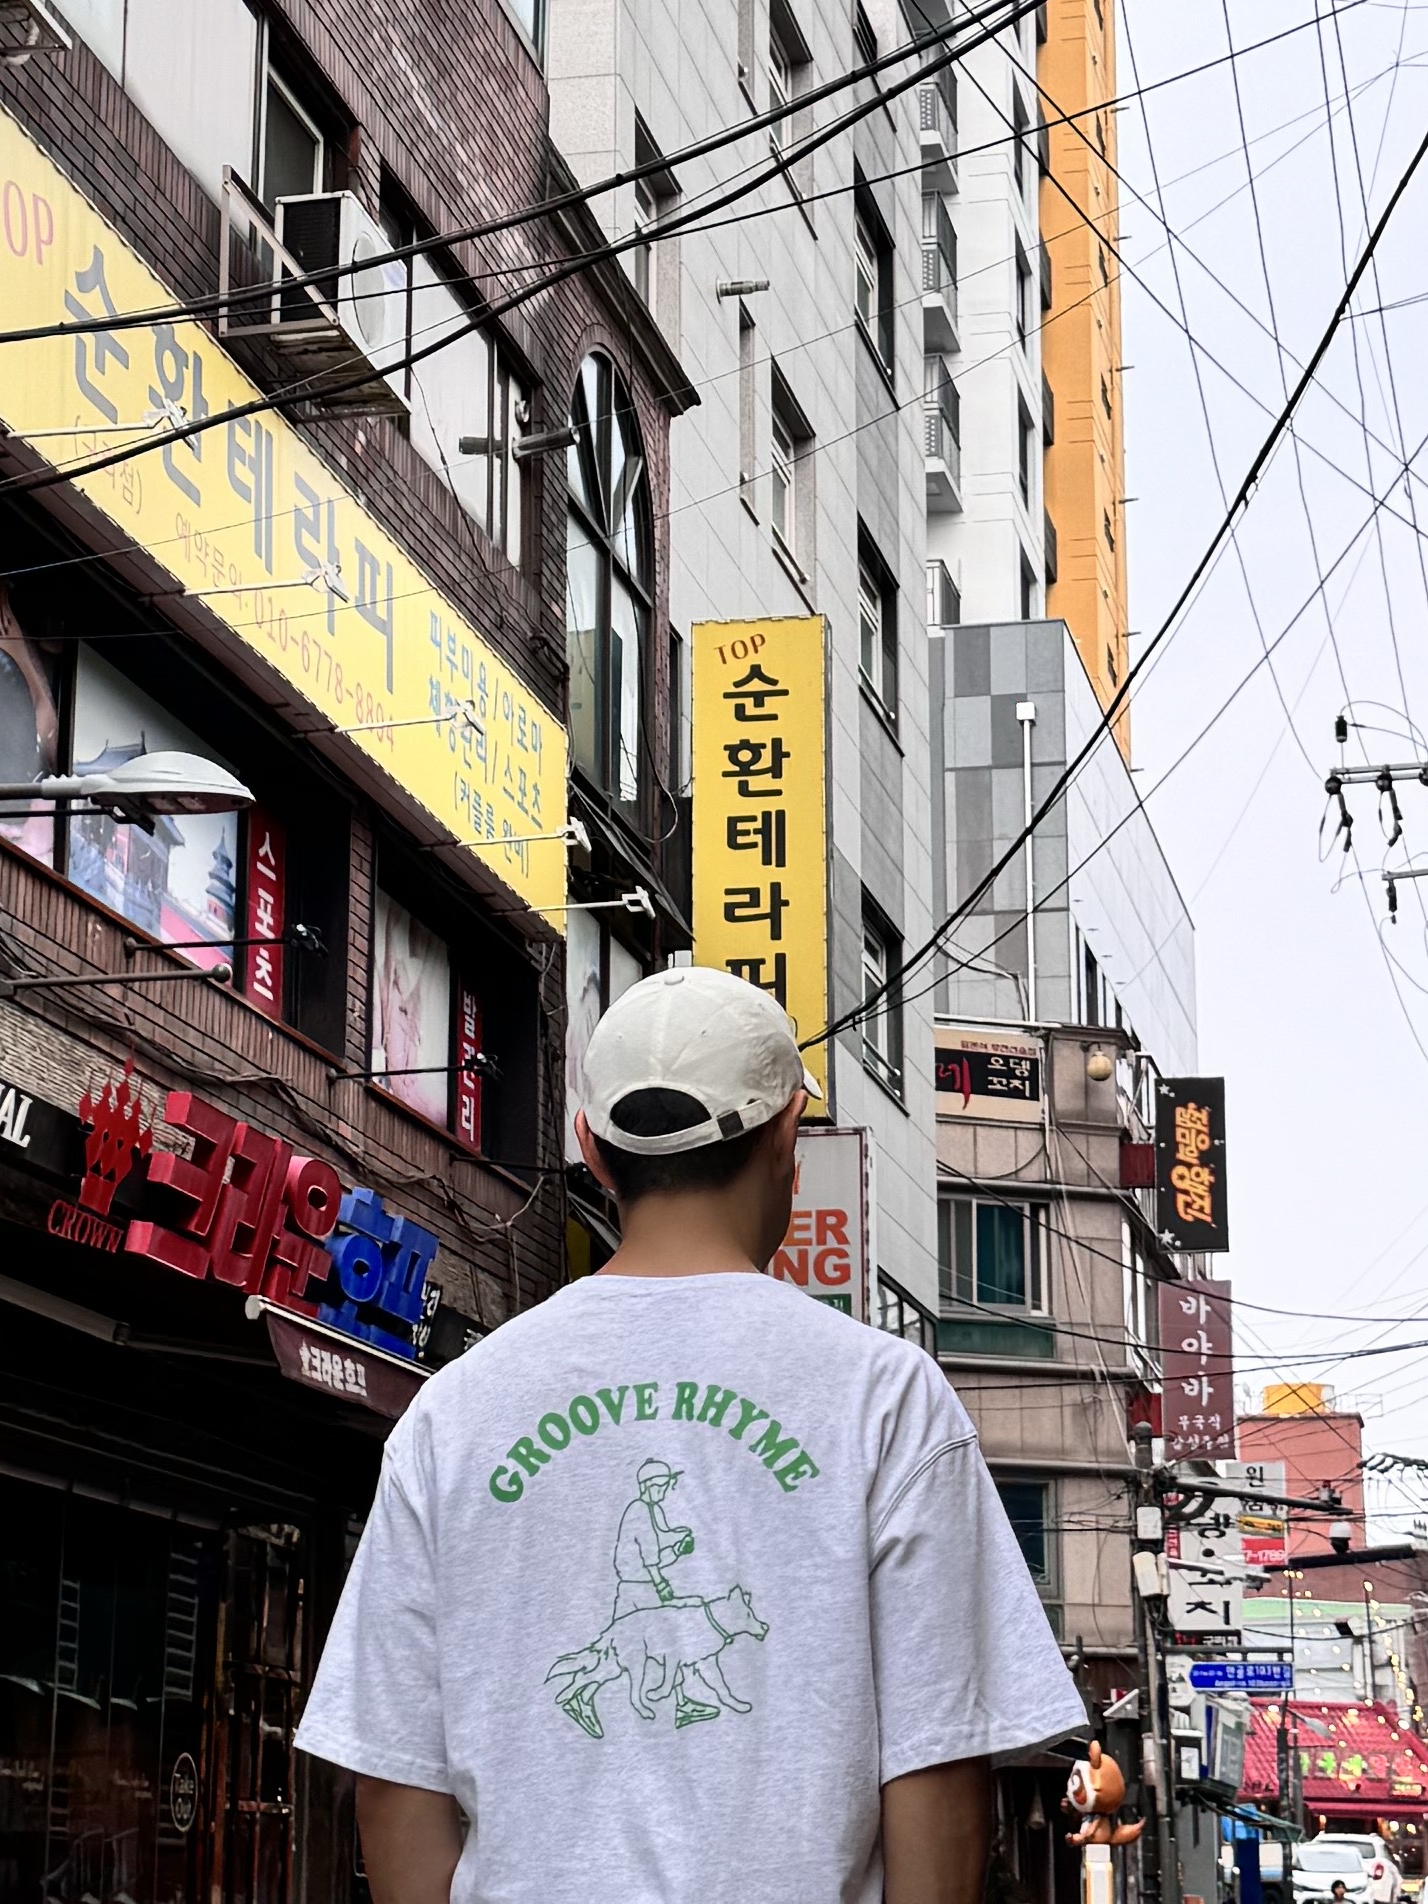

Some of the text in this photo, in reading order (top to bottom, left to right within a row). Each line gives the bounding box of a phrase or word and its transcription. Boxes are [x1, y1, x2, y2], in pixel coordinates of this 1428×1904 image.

[63, 243, 395, 695] 순환테라피
[714, 633, 766, 666] TOP
[46, 1199, 124, 1253] CROWN
[488, 1381, 821, 1504] GROOVE RHYME
